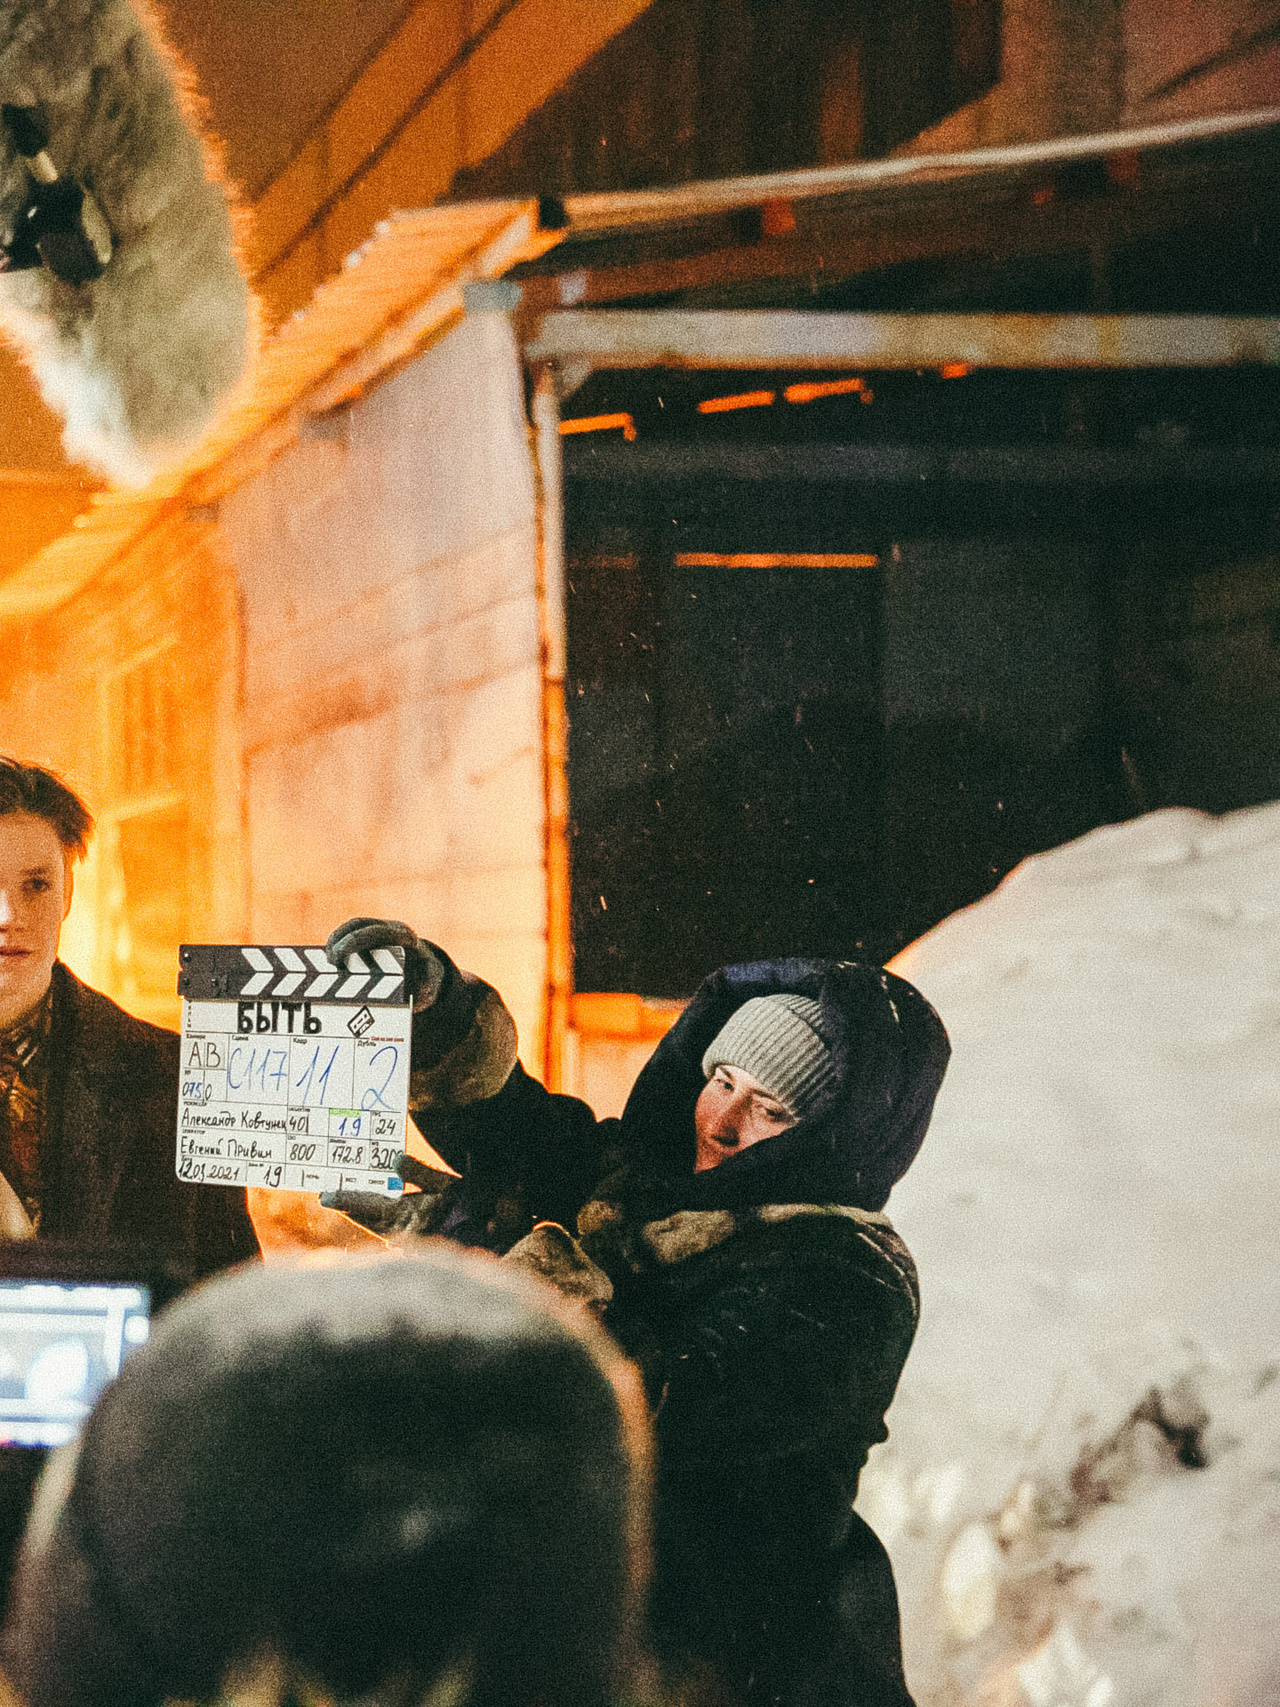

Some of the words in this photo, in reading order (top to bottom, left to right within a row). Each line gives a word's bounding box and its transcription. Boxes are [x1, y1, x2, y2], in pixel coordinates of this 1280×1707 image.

[237, 1001, 322, 1034] БЫТЬ
[296, 1045, 340, 1107] 11
[360, 1046, 398, 1111] 2
[181, 1107, 236, 1127] Александр
[375, 1118, 397, 1135] 24
[181, 1136, 222, 1155] Евгений
[289, 1143, 316, 1161] 800
[332, 1145, 364, 1164] 172.8
[263, 1165, 282, 1188] 19
